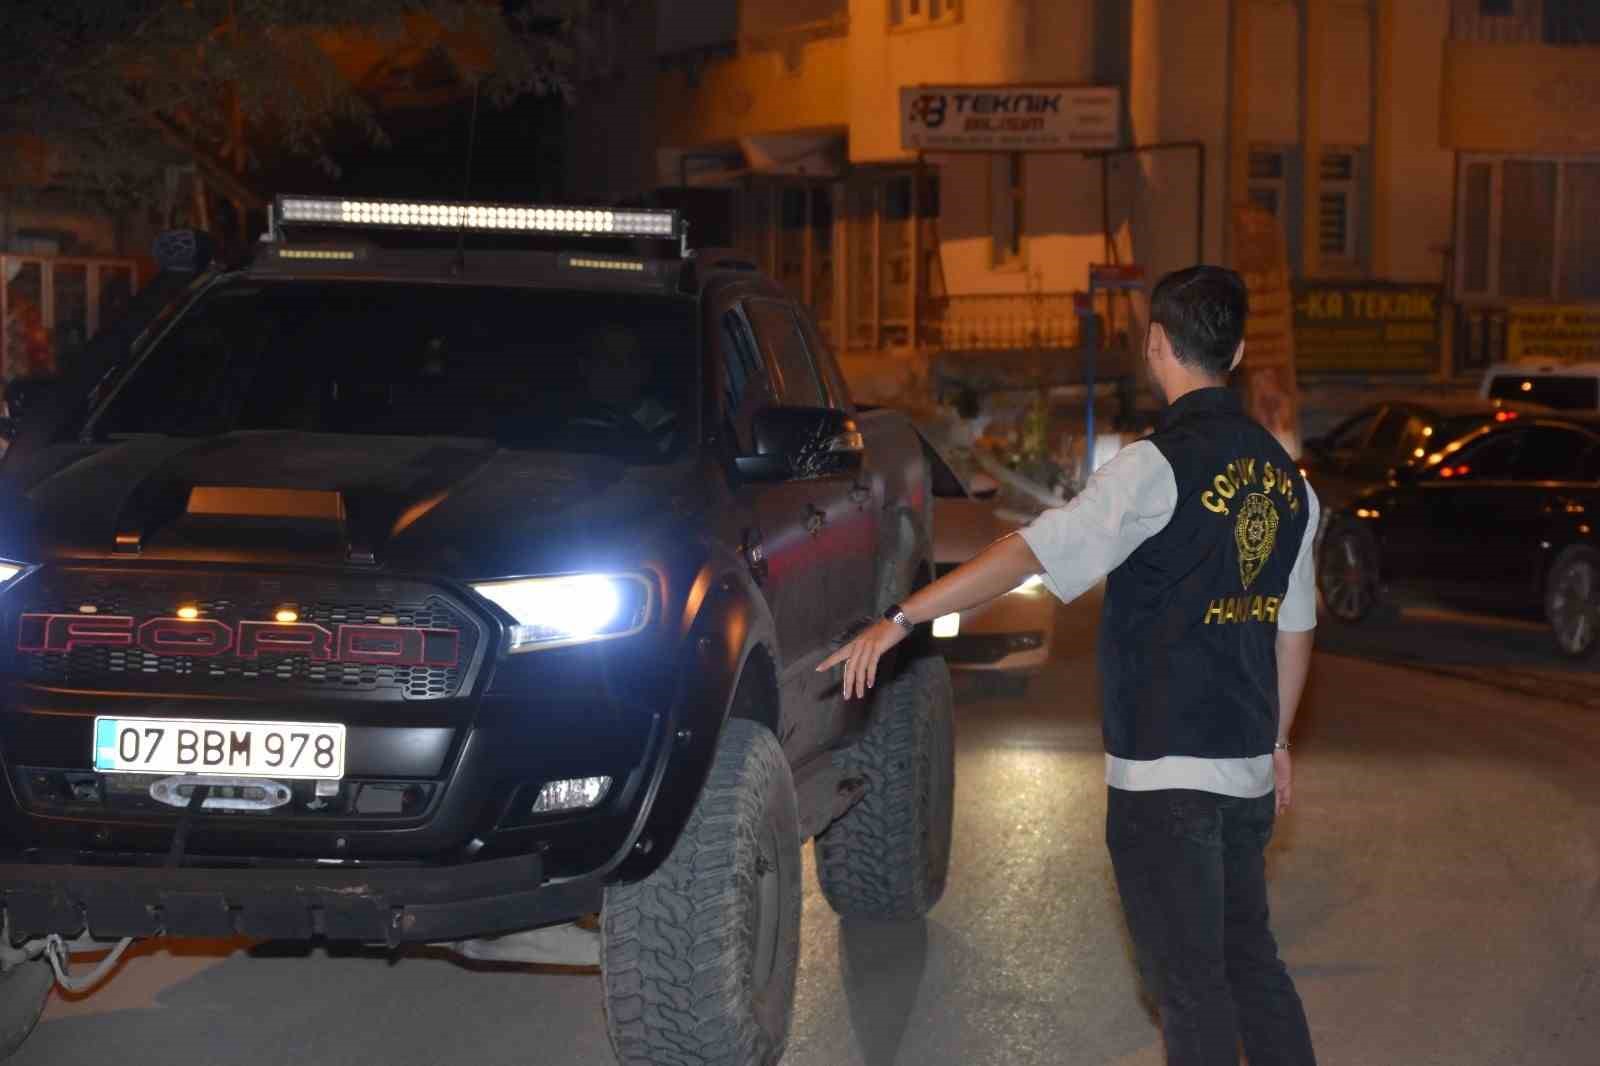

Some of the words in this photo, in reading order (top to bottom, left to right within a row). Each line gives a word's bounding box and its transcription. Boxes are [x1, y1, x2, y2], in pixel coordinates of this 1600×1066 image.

[34, 611, 438, 665] FORD
[119, 727, 165, 763] 07
[177, 729, 251, 767] BBM
[264, 732, 335, 769] 978
